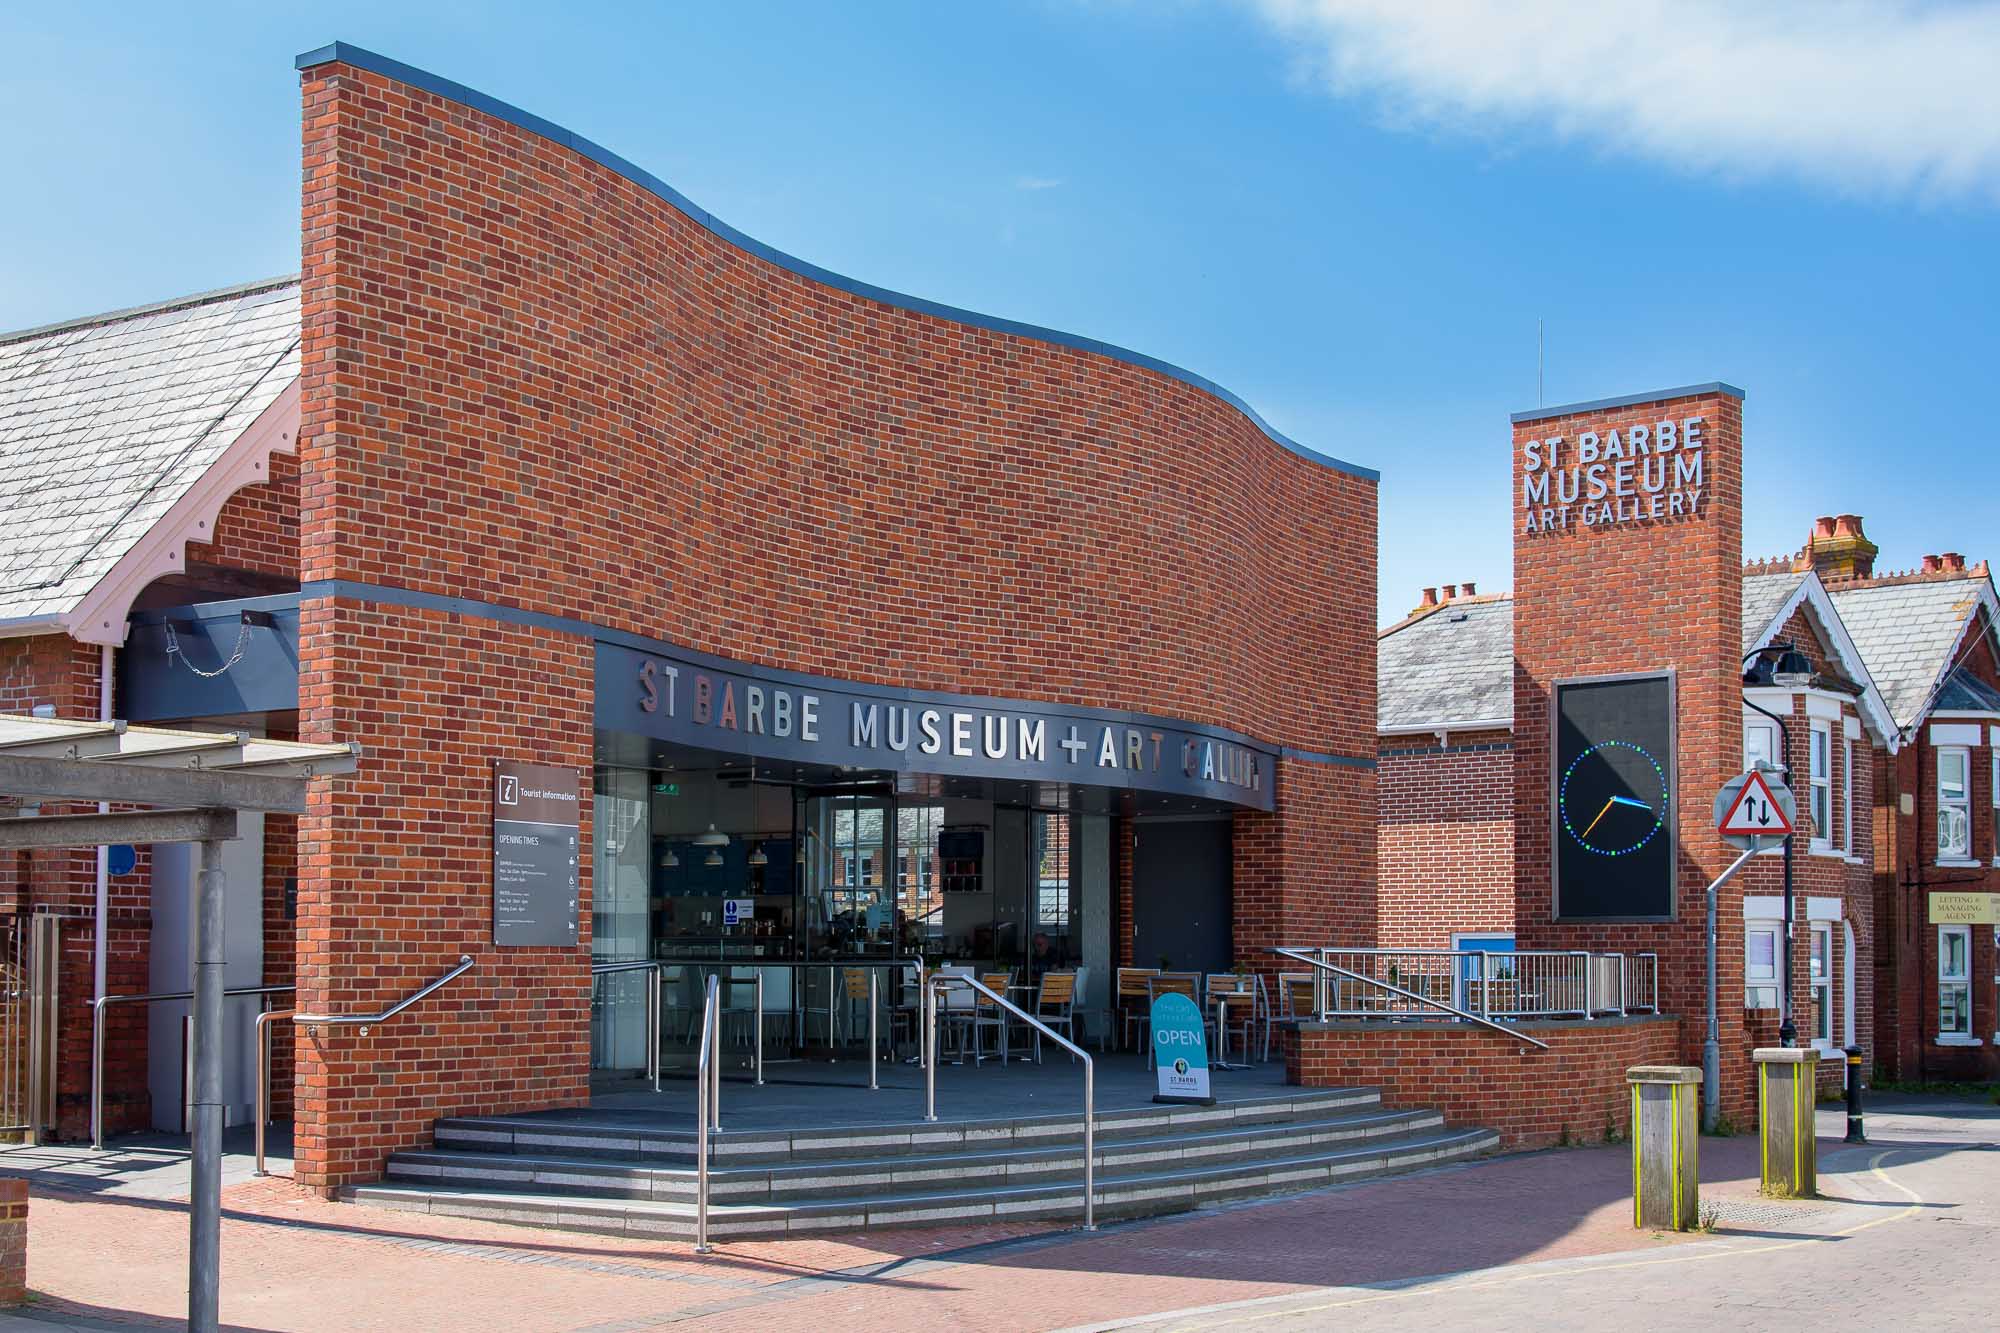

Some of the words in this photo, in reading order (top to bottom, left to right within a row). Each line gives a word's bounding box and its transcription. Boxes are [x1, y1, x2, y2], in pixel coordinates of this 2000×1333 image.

[1523, 437, 1562, 472] ST
[1579, 416, 1703, 464] BARBE
[1523, 451, 1703, 509] MUSEUM
[1524, 505, 1571, 533] ART
[1582, 490, 1702, 527] GALLERY
[639, 659, 679, 717] ST
[692, 674, 819, 742] BARBE
[852, 701, 1046, 762] MUSEUM
[1098, 726, 1165, 773] ART
[1182, 739, 1260, 792] GALL
[520, 787, 541, 799] Tourist
[542, 790, 576, 801] information
[499, 834, 523, 845] OPENING
[523, 835, 539, 846] TIMES
[1937, 904, 1982, 912] MANAGING
[1944, 912, 1976, 920] AGENTS
[1157, 1030, 1202, 1045] OPEN
